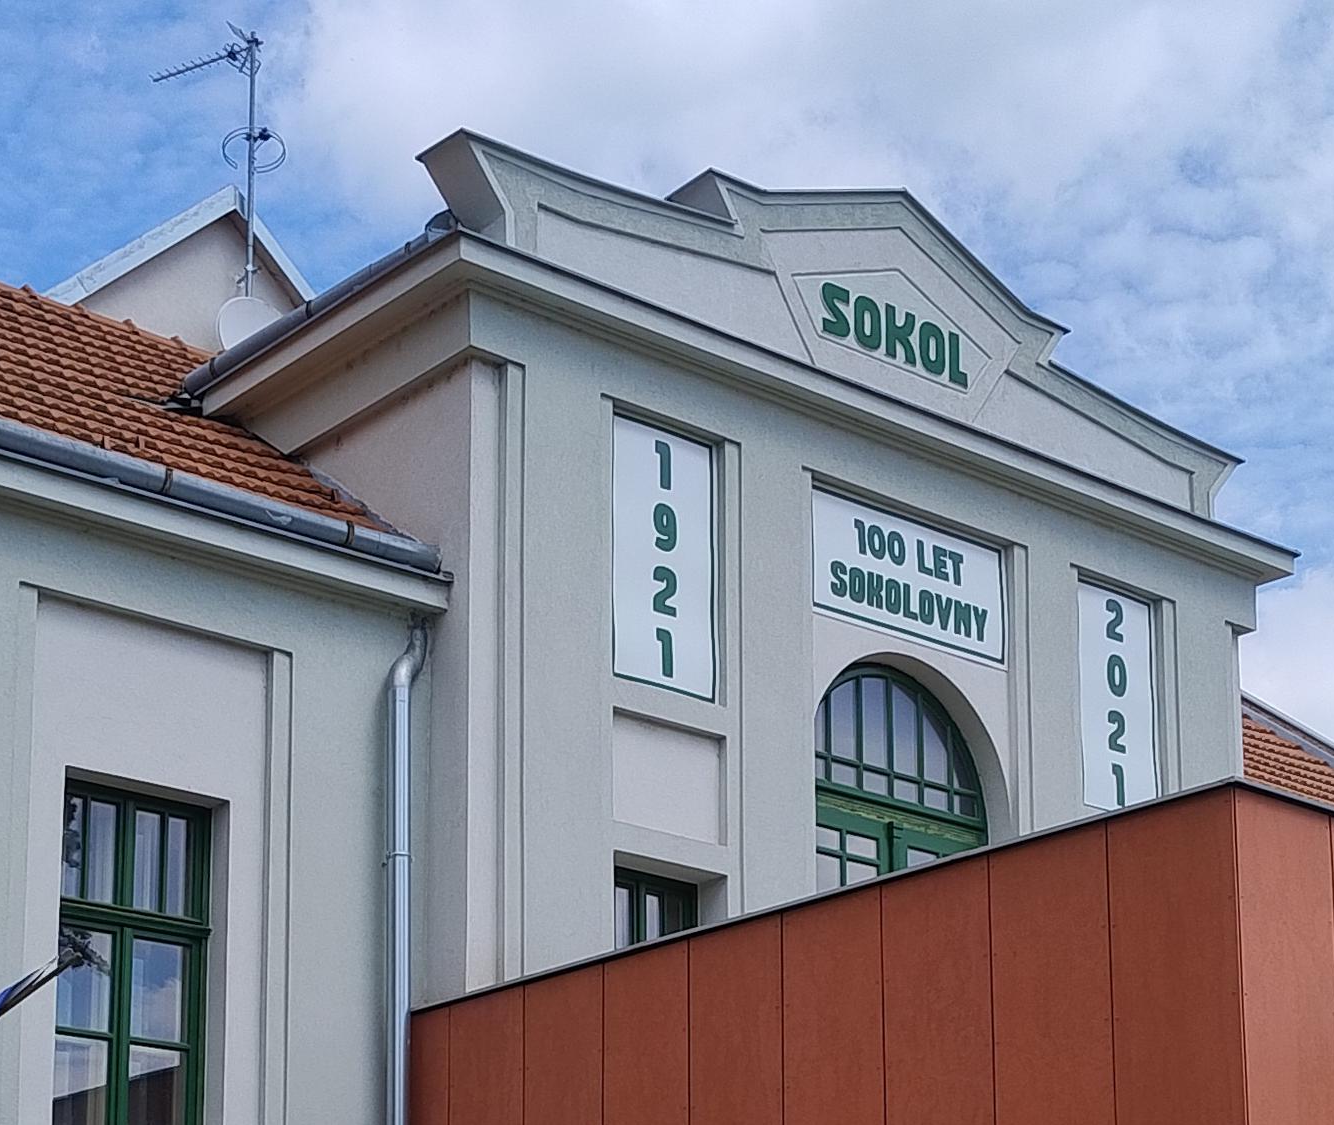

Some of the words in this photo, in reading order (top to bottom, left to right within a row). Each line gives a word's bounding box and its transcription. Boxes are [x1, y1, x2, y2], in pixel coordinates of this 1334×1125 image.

[821, 282, 968, 388] SOKOL
[652, 439, 677, 679] 1921
[830, 560, 988, 642] SOKOLOVNY
[854, 518, 906, 566] 100
[917, 538, 964, 587] LET
[1105, 599, 1127, 807] 2021
